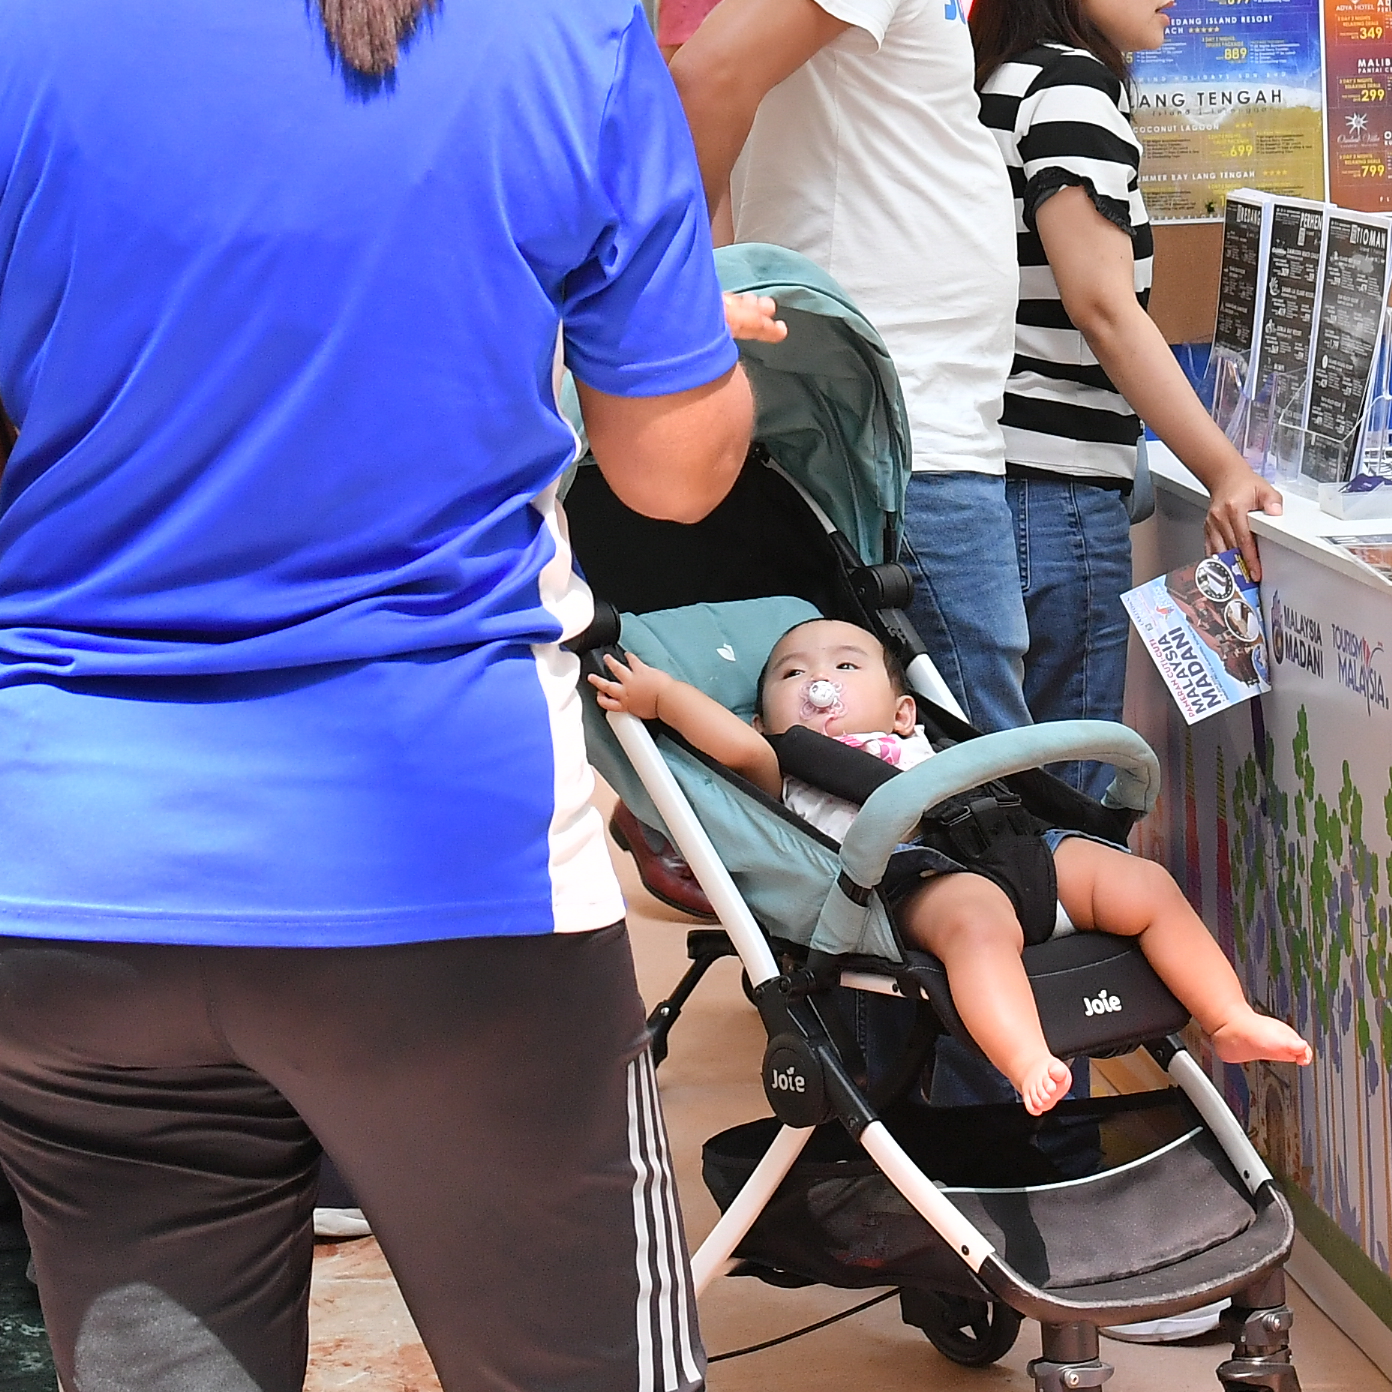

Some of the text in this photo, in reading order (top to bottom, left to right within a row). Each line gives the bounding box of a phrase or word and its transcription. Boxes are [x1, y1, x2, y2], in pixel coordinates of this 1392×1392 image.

[1205, 16, 1237, 24] ISLAND
[1241, 15, 1273, 23] RESORT
[1360, 27, 1383, 40] 349
[1197, 89, 1282, 106] TENGAH
[1361, 89, 1385, 101] 299
[1134, 123, 1220, 134] COCONUT LAGOON
[1192, 172, 1216, 180] LANG
[1361, 165, 1385, 177] 799
[1300, 213, 1323, 230] PERHEN
[1357, 227, 1387, 249] TIOMAN
[1283, 605, 1323, 646] MALAYSIA
[1331, 623, 1363, 657] TOURISM
[1168, 625, 1222, 709] MADANI
[1285, 631, 1324, 679] MADANI
[1158, 633, 1207, 714] MALAYSIA
[1338, 653, 1385, 716] MALAYSIA
[1171, 679, 1195, 718] PAMERAN
[1084, 989, 1122, 1018] Joie
[771, 1066, 807, 1093] Joie
